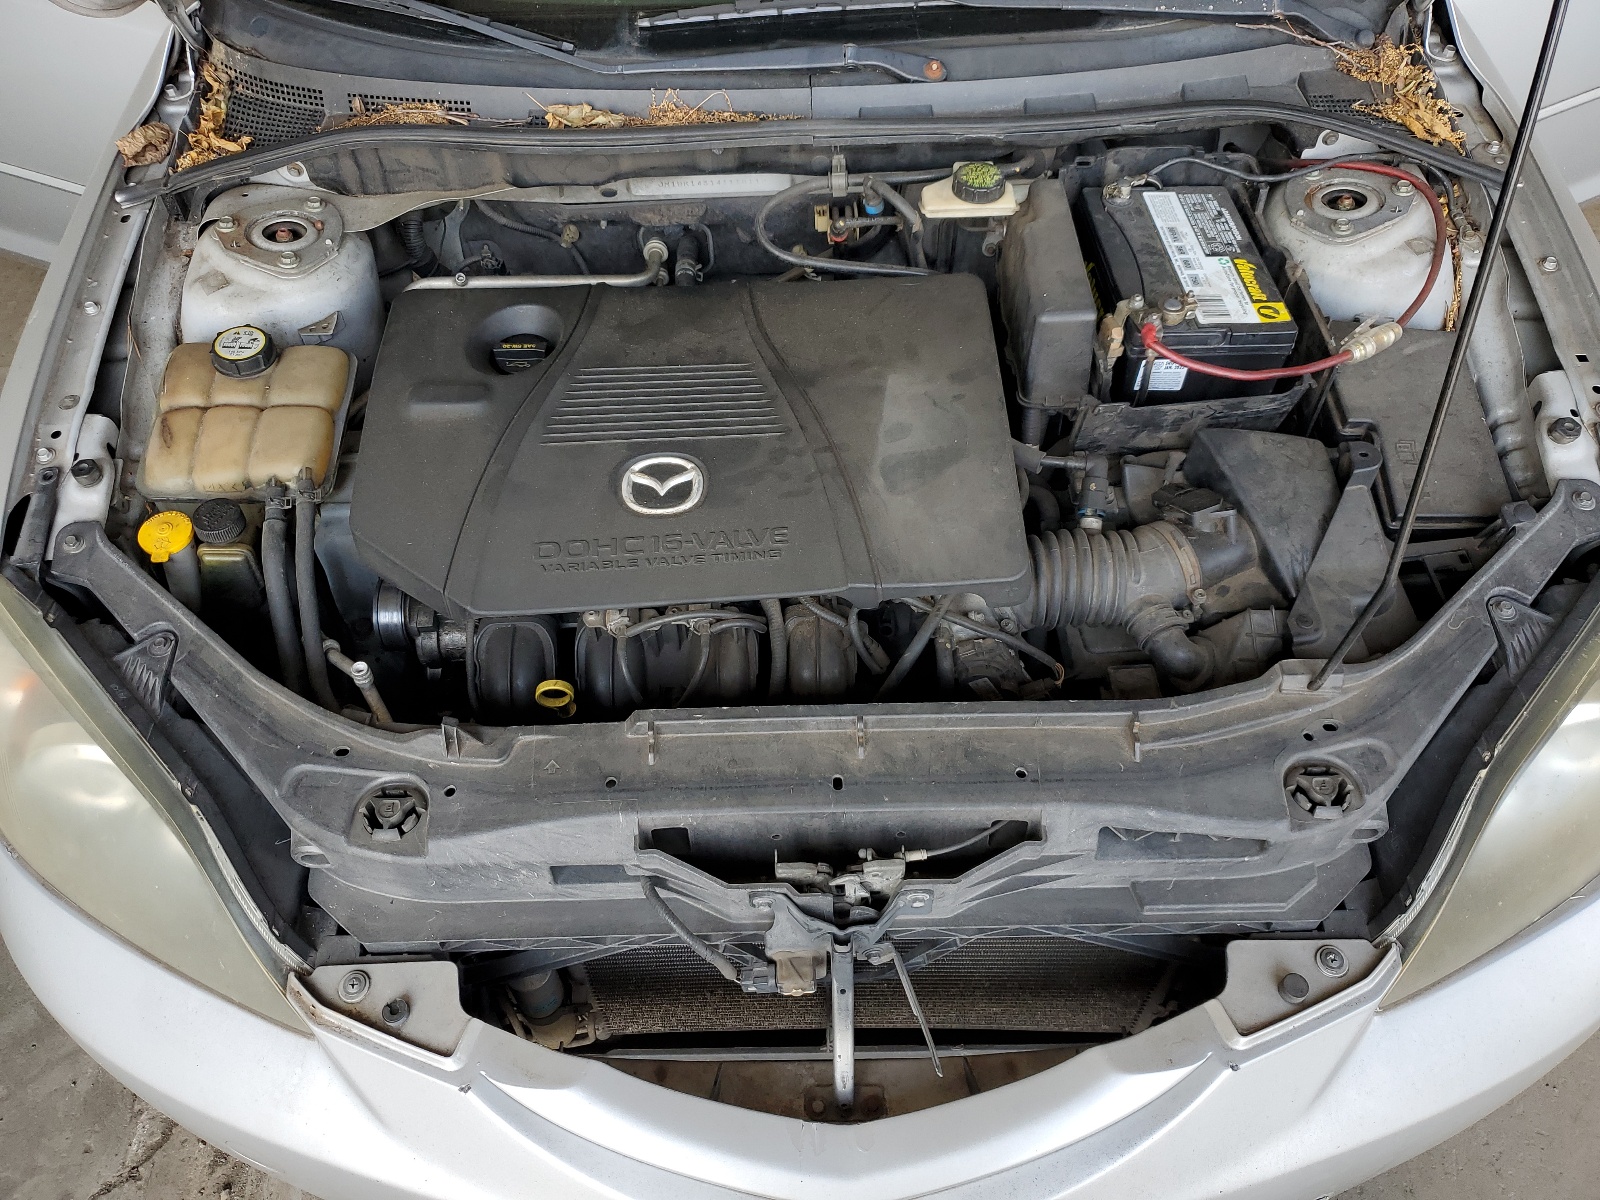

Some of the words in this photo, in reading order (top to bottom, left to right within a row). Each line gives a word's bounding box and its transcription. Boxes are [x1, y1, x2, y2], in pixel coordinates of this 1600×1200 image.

[534, 536, 645, 559] DOHC
[651, 526, 790, 553] 16-VALVE
[540, 558, 640, 573] VARIABLE
[645, 554, 707, 568] VALVE
[710, 549, 782, 563] TIMING
